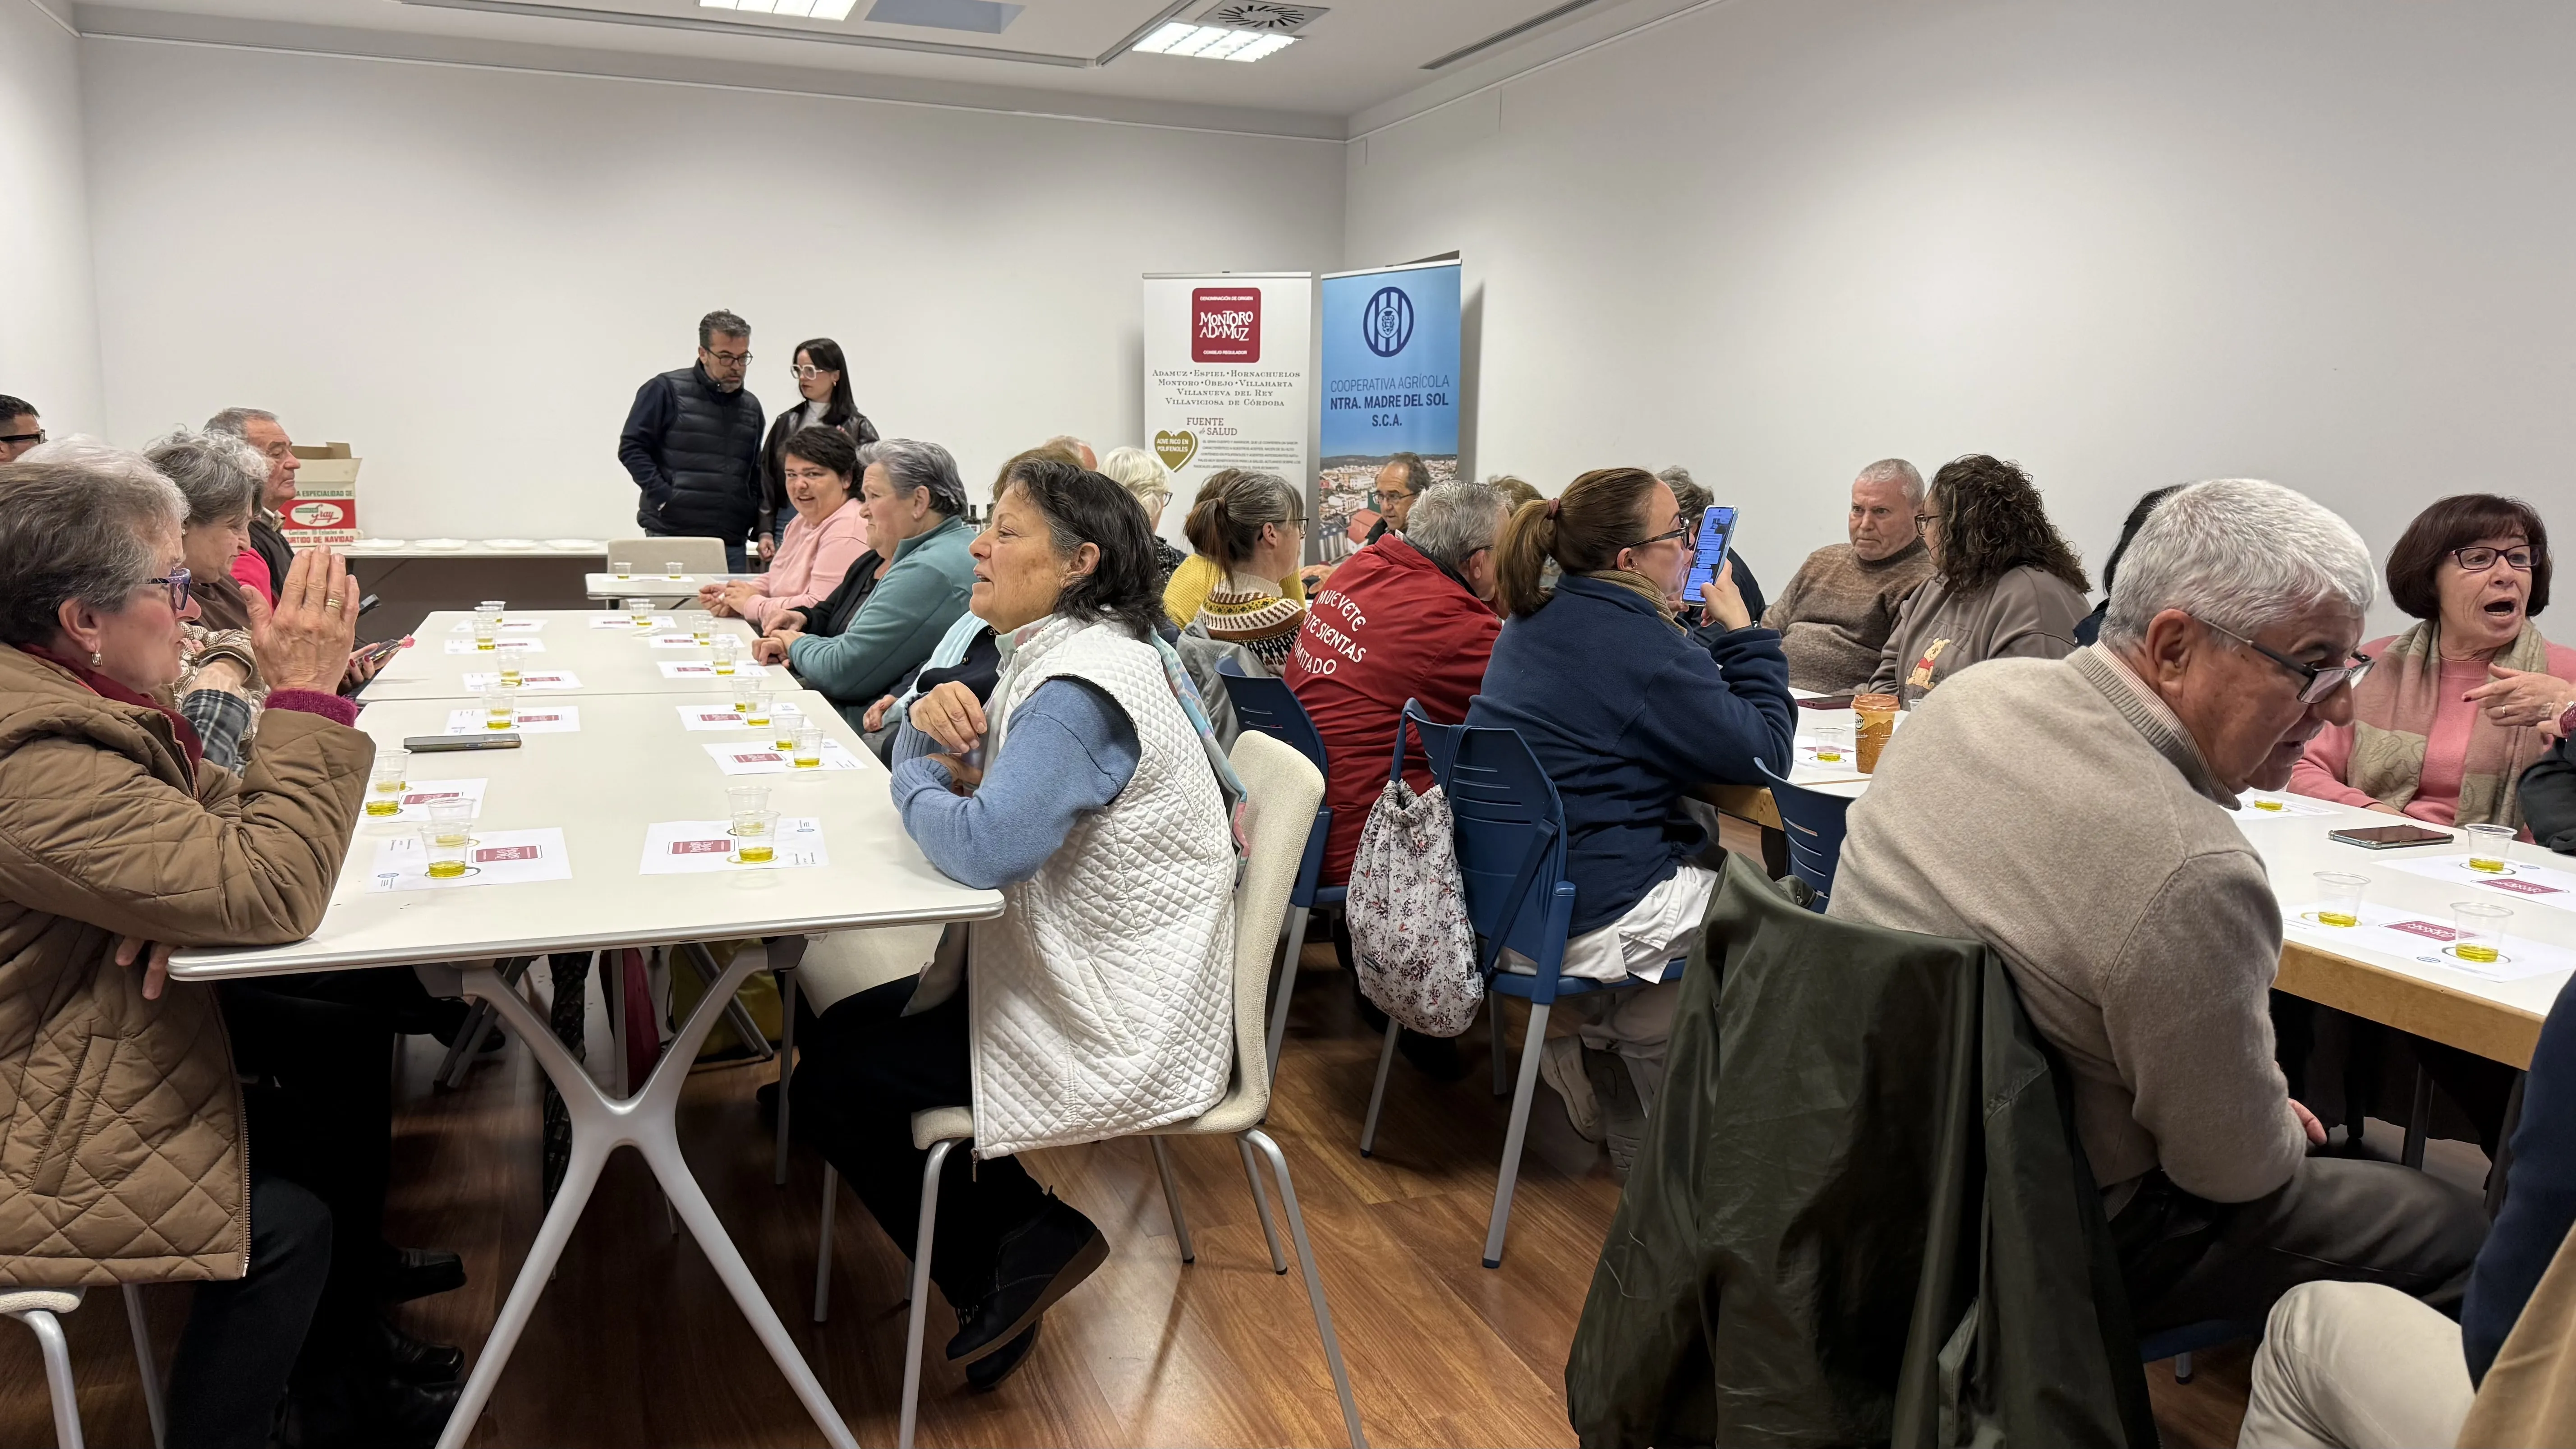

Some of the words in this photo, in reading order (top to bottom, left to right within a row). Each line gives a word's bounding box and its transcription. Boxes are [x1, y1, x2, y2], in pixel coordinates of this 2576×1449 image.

[1199, 310, 1253, 327] MONTORO
[1199, 325, 1249, 341] ADAMUZ
[1231, 370, 1300, 378] HORNACHUELOS
[1330, 378, 1395, 392] COOPERATIVA
[1398, 373, 1449, 389] AGRÍCOLA
[1165, 397, 1224, 405] VILLAVICIOSA
[1330, 397, 1361, 410] NTRA.
[1364, 395, 1401, 409] MADRE
[1403, 394, 1424, 407] DEL
[1426, 393, 1449, 406] SOL
[1187, 417, 1224, 426] FUENTE
[1371, 414, 1403, 427] S.C.A.
[1206, 428, 1237, 436] SALUD
[1316, 589, 1366, 632] MUEVETE
[1306, 614, 1321, 634] TE
[1315, 623, 1367, 663] SIENTAS
